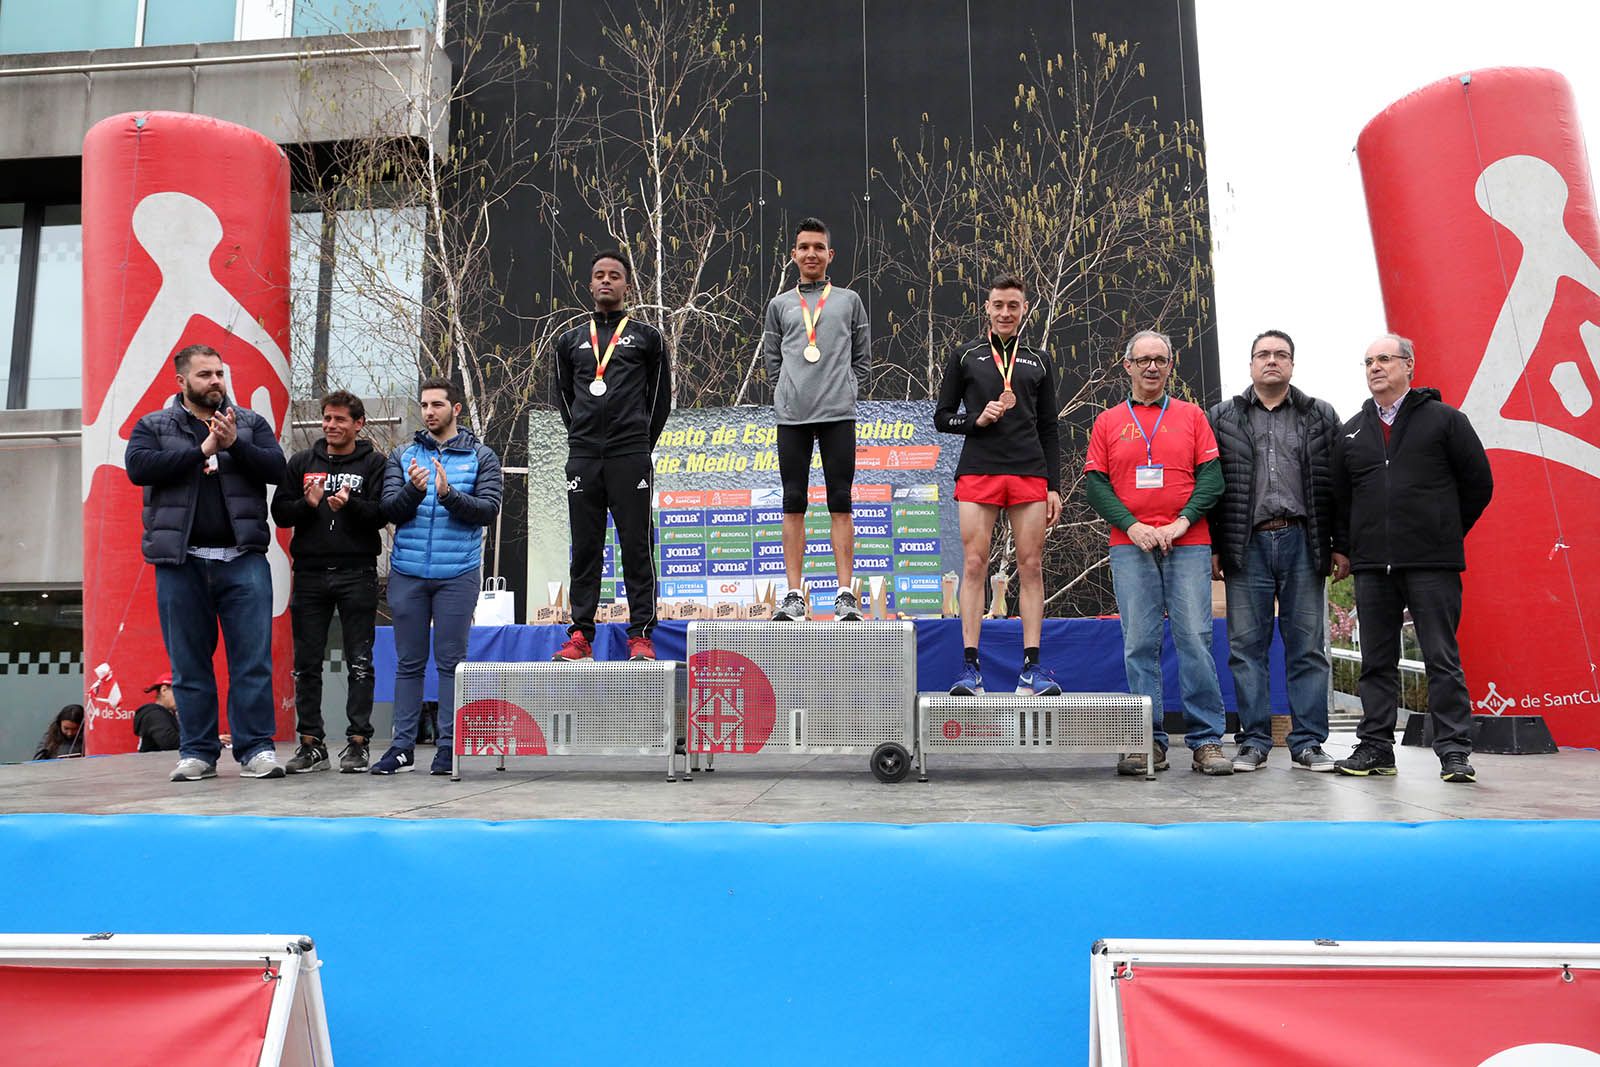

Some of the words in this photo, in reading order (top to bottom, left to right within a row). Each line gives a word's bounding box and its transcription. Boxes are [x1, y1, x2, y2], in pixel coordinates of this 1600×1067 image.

[711, 425, 737, 445] de
[742, 423, 778, 448] Esp
[855, 419, 915, 439] soluto
[656, 454, 681, 474] de
[686, 452, 747, 472] Medio
[756, 512, 784, 522] Jom
[758, 546, 784, 556] Jom
[805, 544, 833, 554] Jom
[758, 562, 786, 572] Jom
[1521, 694, 1541, 708] de
[1543, 690, 1600, 707] SantCu
[102, 706, 114, 719] de
